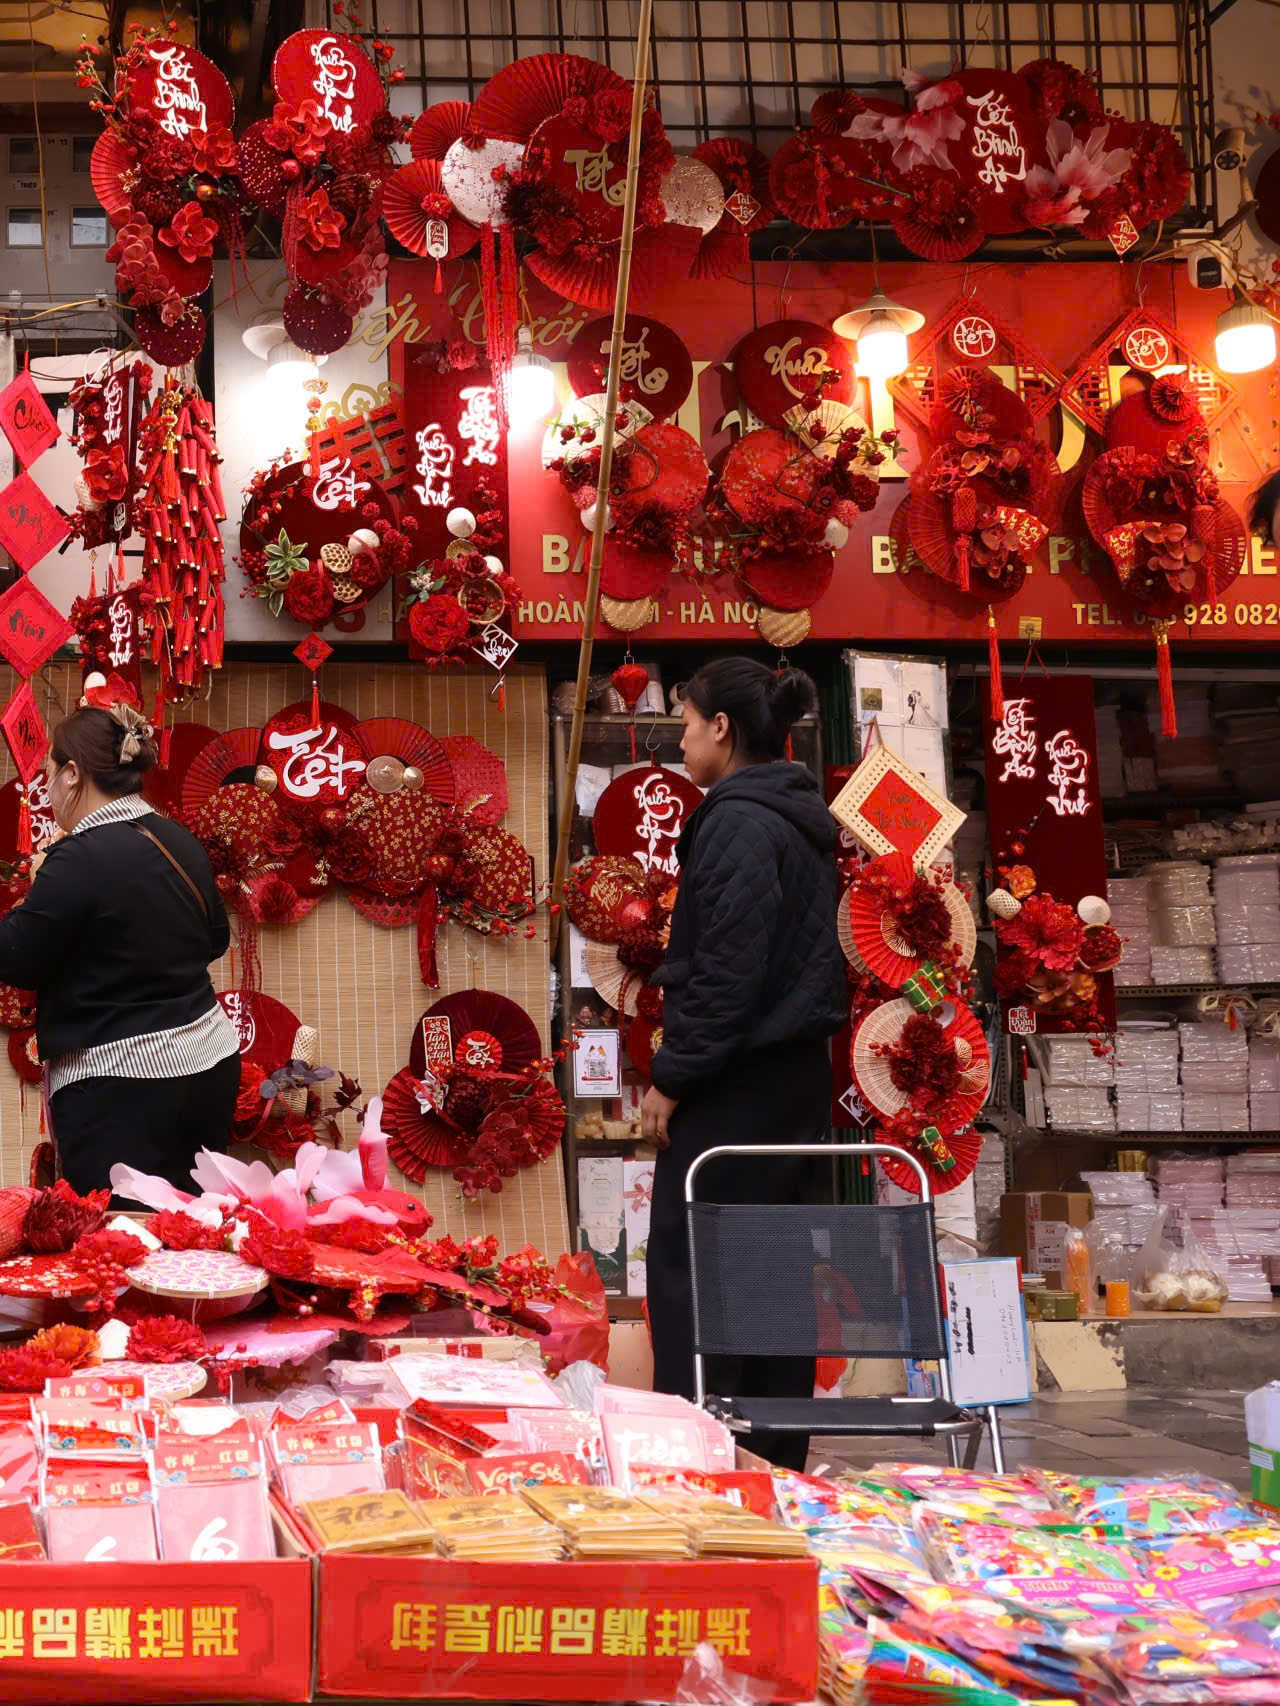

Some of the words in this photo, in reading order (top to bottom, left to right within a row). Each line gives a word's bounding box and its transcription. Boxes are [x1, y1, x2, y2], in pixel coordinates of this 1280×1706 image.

[148, 47, 191, 82] Tết
[967, 91, 1014, 128] Tết
[301, 457, 370, 511] Tết
[680, 595, 715, 624] HÀ
[1184, 603, 1228, 625] 928
[269, 727, 366, 797] Tết
[466, 1038, 494, 1069] Tết
